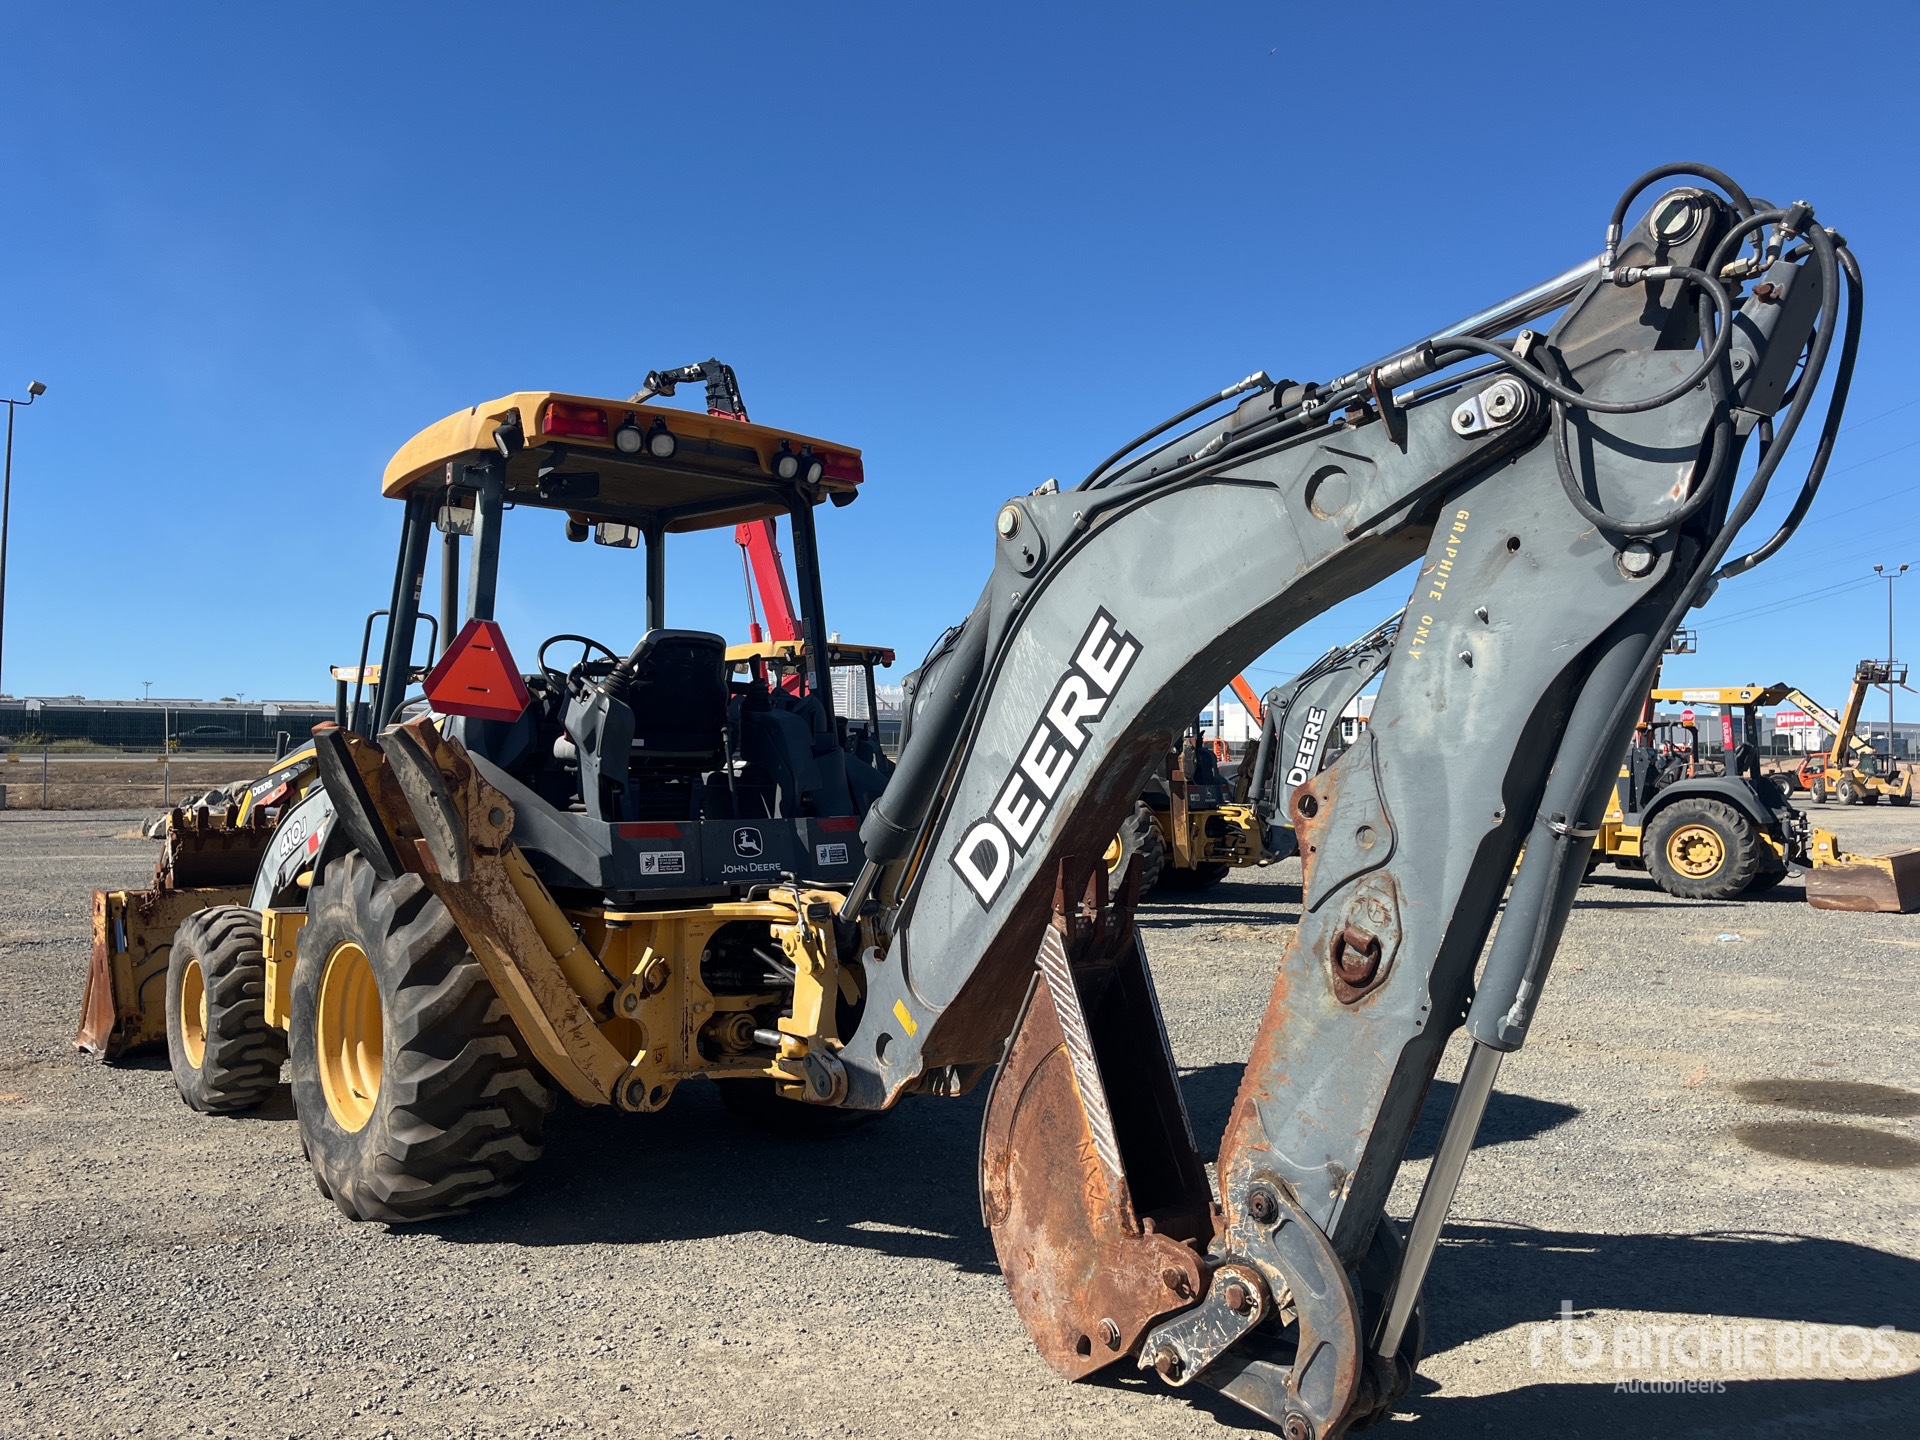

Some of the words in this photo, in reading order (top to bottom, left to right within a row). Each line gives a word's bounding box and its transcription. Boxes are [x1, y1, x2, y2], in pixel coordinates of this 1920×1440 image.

[1429, 510, 1470, 600] GRAPHITE
[1409, 615, 1433, 660] ONLY
[1804, 705, 1818, 714] JLG
[950, 607, 1142, 911] DEERE
[1286, 706, 1327, 787] DEERE
[252, 779, 273, 797] DEERE
[280, 816, 307, 857] 410J
[721, 864, 748, 874] JOHN
[749, 862, 782, 873] DEERE
